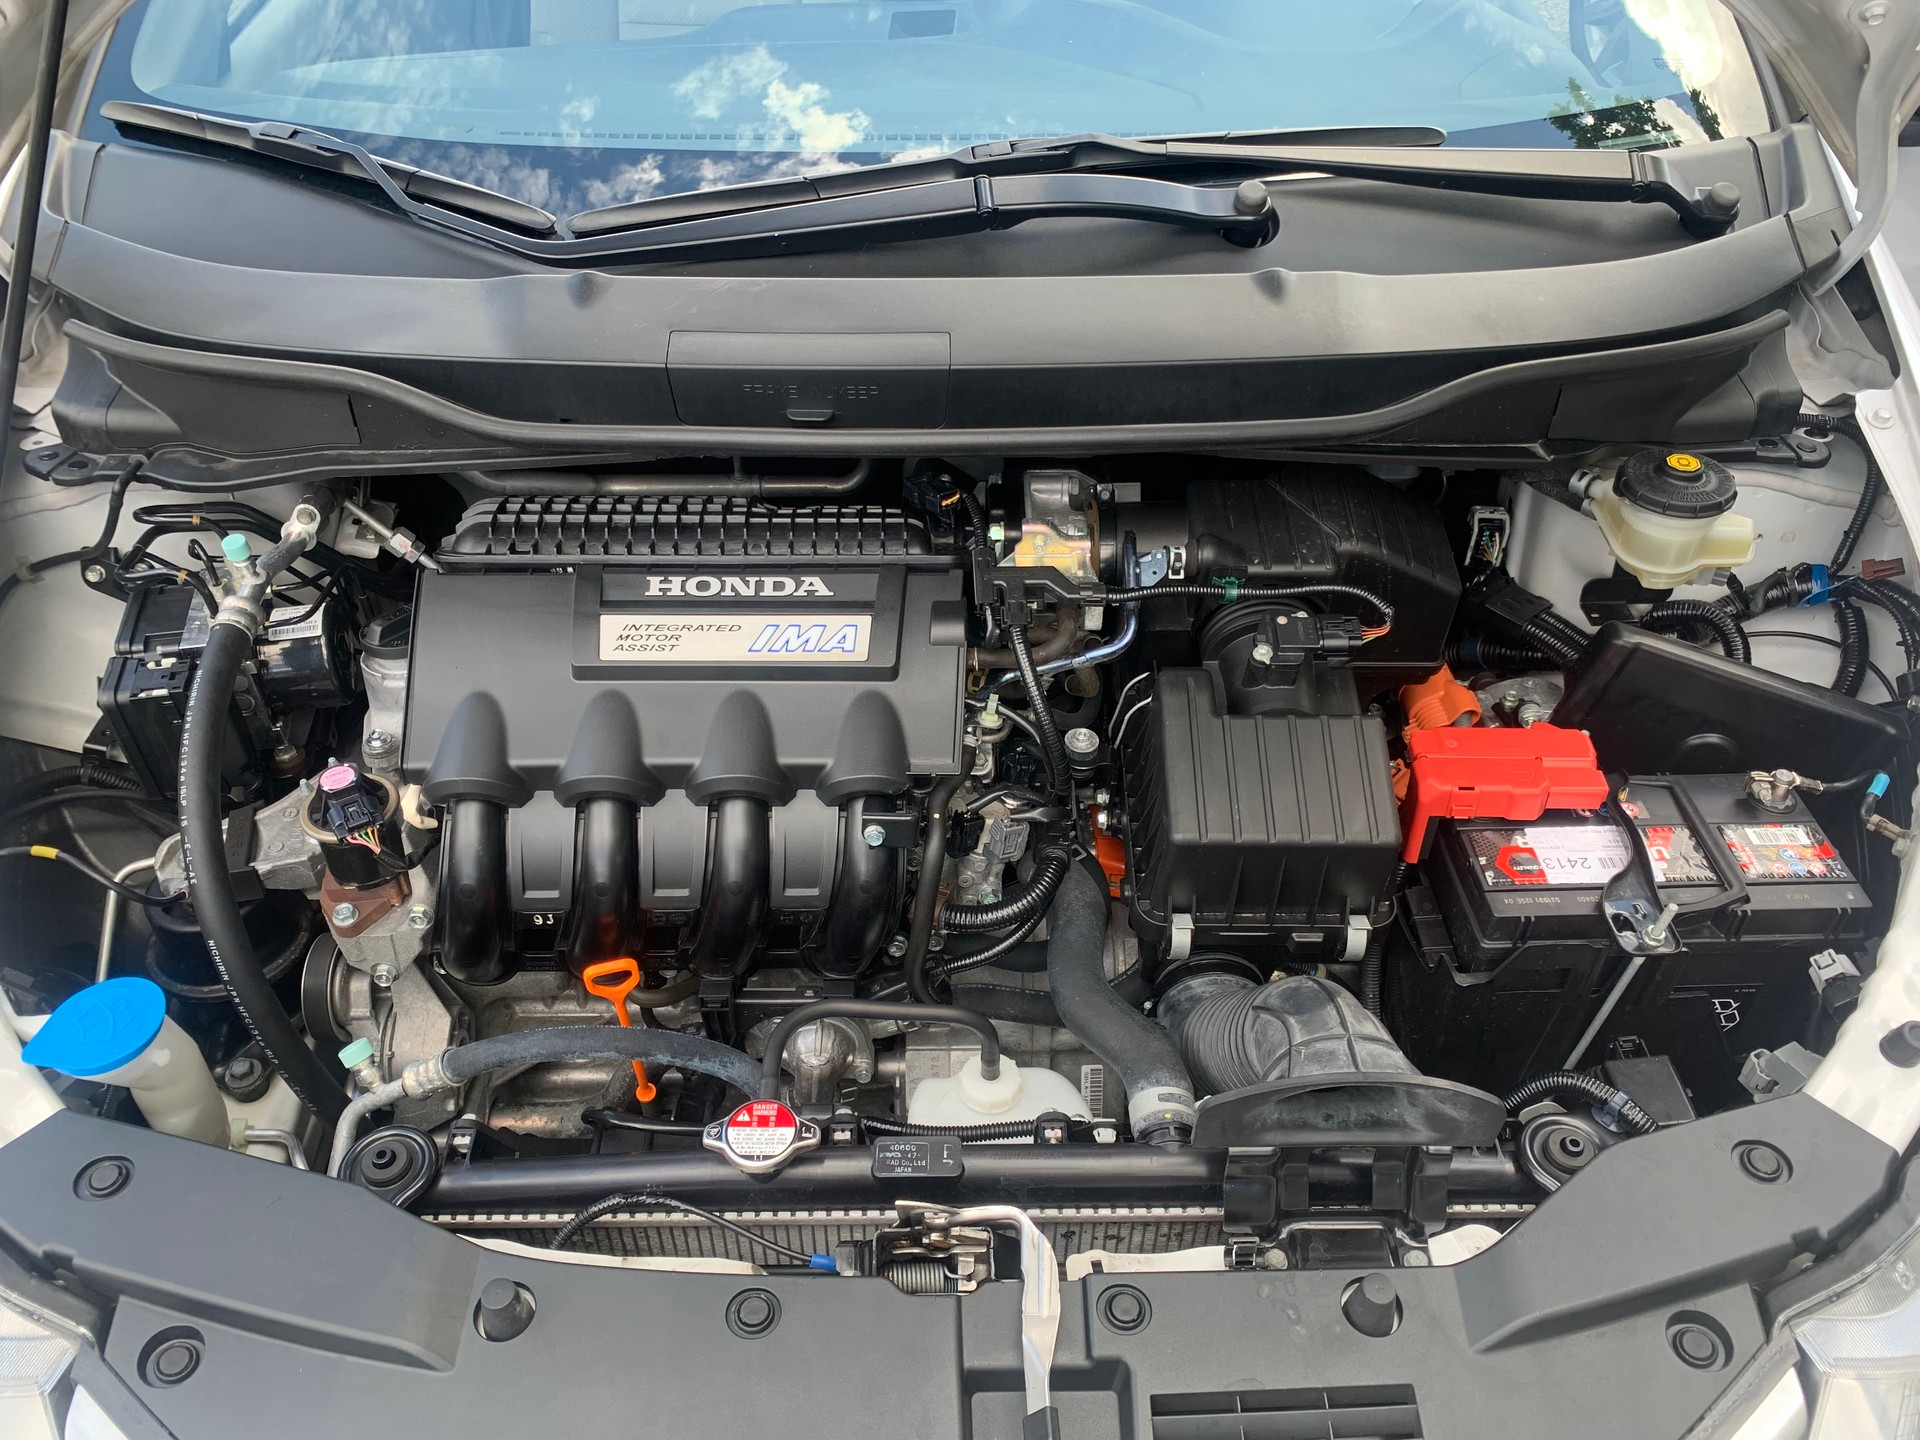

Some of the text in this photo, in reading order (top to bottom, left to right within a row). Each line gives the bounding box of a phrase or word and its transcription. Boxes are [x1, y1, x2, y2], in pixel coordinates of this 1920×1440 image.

[743, 385, 879, 399] FRAME NUMBER
[644, 576, 834, 597] HONDA
[621, 623, 742, 632] INTEGRATED
[615, 634, 682, 642] MOTOR
[747, 624, 858, 652] IMA
[613, 644, 680, 652] ASSIST
[189, 669, 203, 707] NICHIRIN
[184, 711, 193, 729] JPN
[1542, 857, 1592, 870] 2413
[208, 939, 230, 981] NICHIRIN
[227, 984, 241, 1003] JPN
